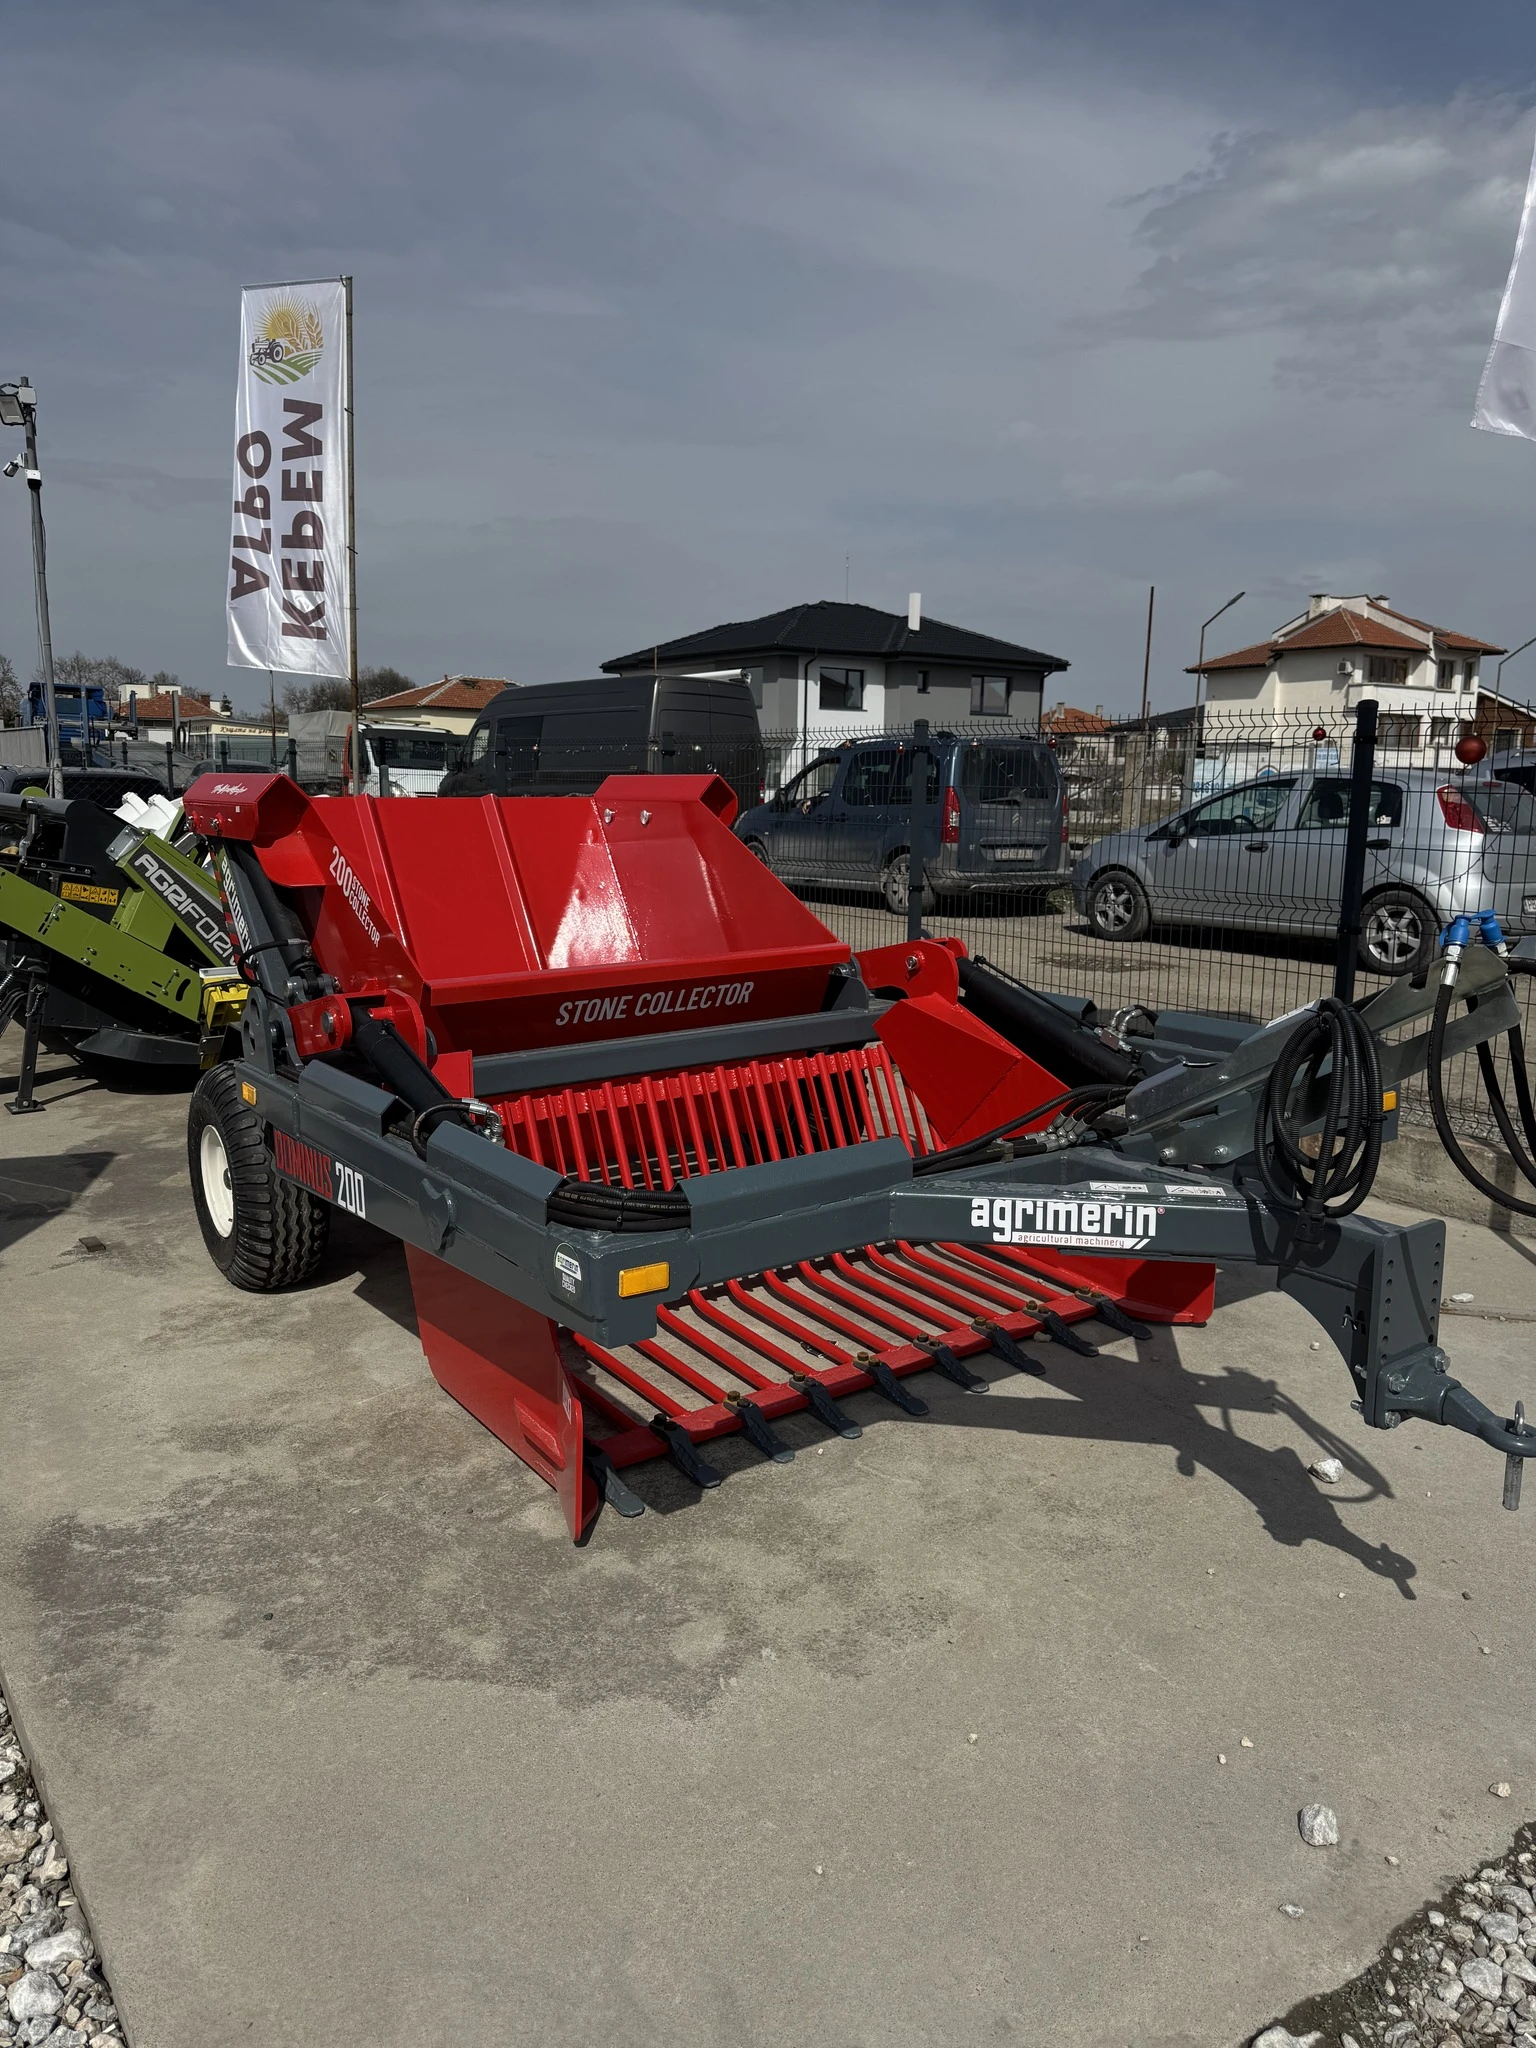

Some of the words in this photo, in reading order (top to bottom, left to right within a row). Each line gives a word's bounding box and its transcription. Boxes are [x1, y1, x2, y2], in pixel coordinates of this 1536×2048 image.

[329, 845, 353, 897] 200
[351, 875, 371, 913] STONE
[348, 890, 381, 948] COLLECTOR
[555, 995, 633, 1026] STONE
[634, 981, 755, 1017] COLLECTOR
[273, 1129, 333, 1200] DOMINUS
[335, 1161, 366, 1220] 200
[970, 1198, 1157, 1243] agrimerin
[1018, 1233, 1073, 1245] agricultural
[1075, 1236, 1125, 1249] machinery
